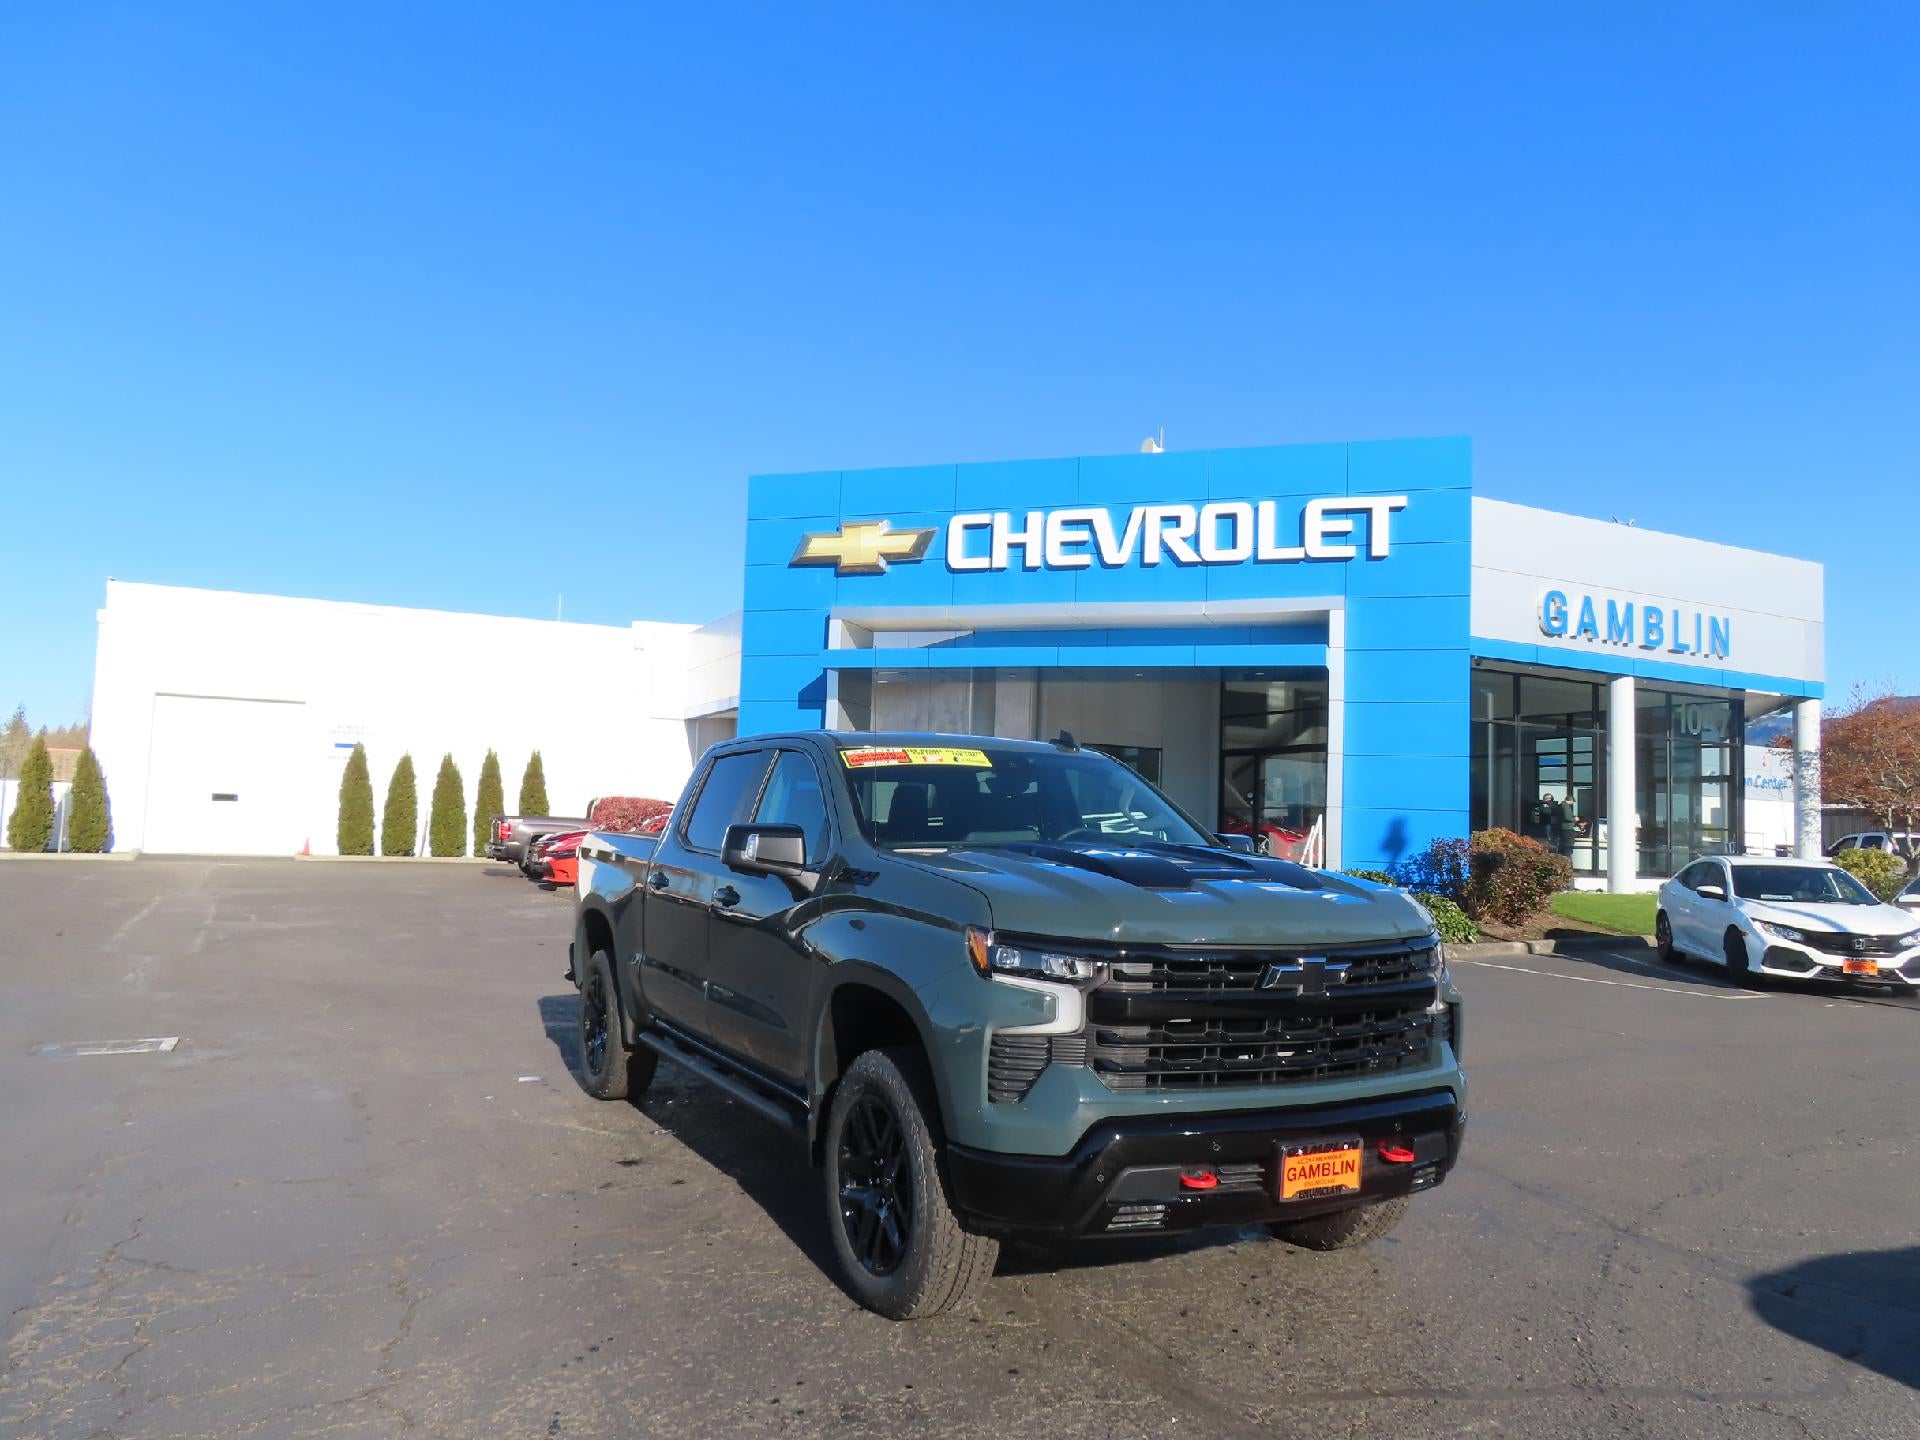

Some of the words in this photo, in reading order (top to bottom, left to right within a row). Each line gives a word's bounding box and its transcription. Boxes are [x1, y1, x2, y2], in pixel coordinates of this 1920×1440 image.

[947, 495, 1408, 570] CHEVROLET
[1540, 590, 1731, 658] GAMBLIN
[1287, 1160, 1355, 1182] GAMBLIN
